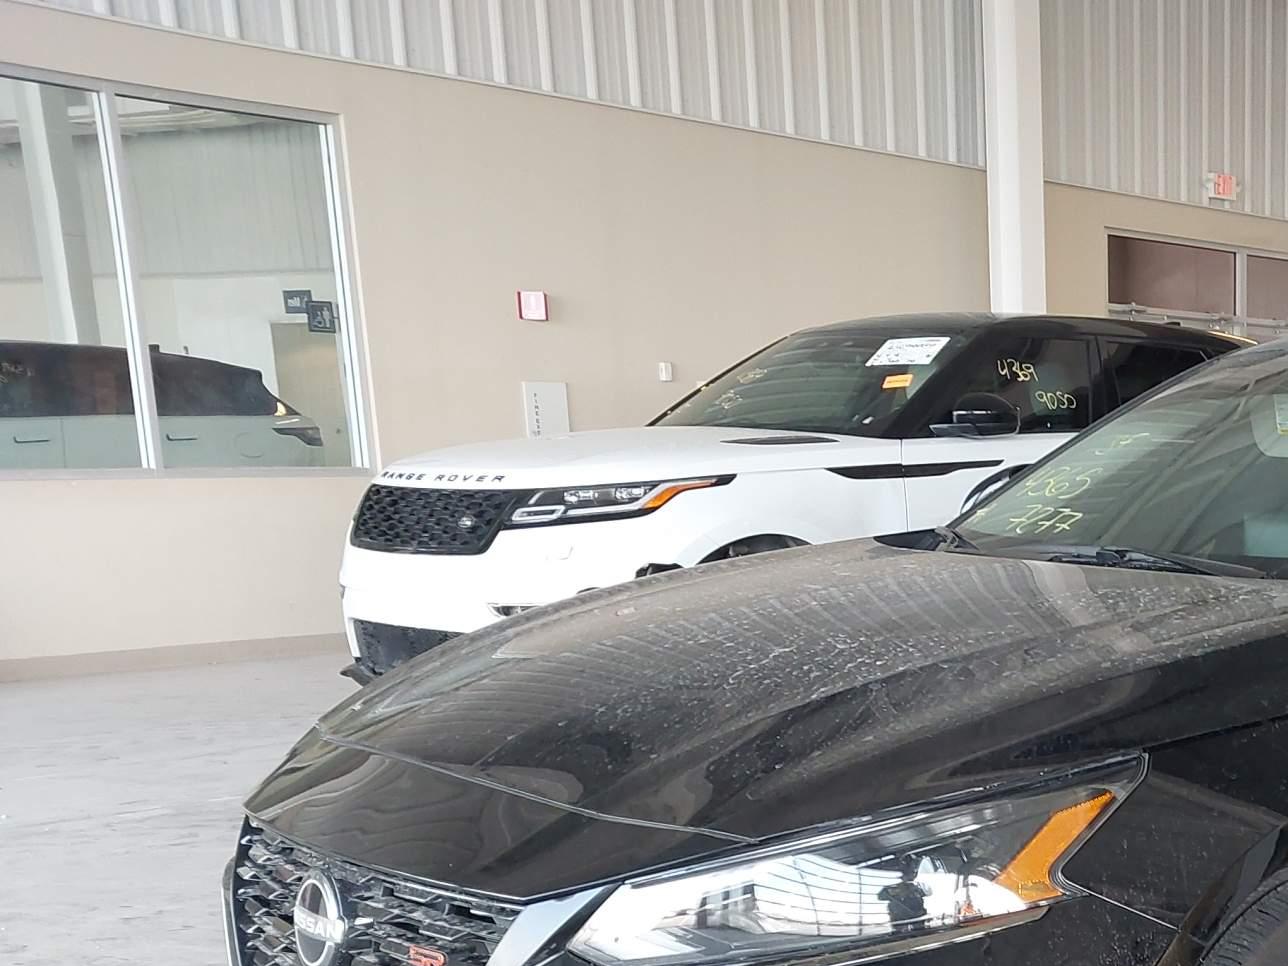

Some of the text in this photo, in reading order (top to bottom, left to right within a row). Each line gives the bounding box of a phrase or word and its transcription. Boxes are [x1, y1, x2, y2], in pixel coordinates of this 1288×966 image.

[997, 358, 1039, 382] 4369
[379, 470, 506, 482] RANGE ROVER
